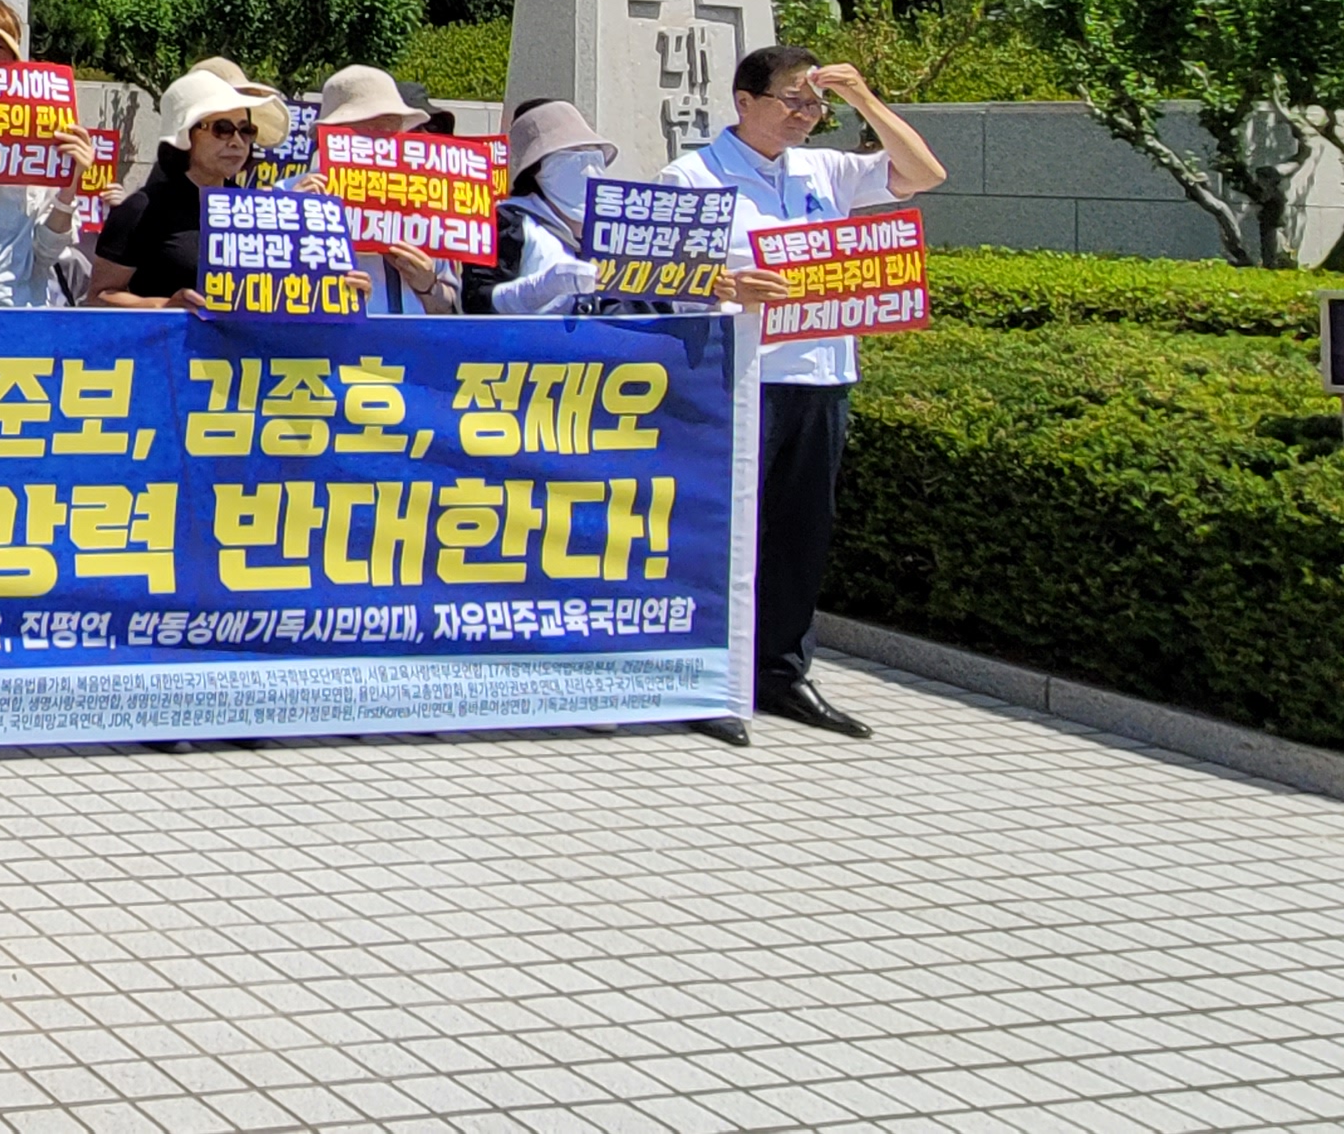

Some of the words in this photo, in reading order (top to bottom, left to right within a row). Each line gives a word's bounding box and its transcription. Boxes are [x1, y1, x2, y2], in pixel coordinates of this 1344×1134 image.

[36, 105, 74, 138] 판사
[327, 134, 397, 168] 법문언
[403, 140, 488, 179] 무시하는
[207, 194, 300, 230] 동성결혼
[303, 198, 345, 233] 옹호
[326, 167, 448, 211] 사법적극주의
[453, 180, 491, 217] 판사
[595, 184, 699, 223] 동성결혼
[700, 192, 734, 224] 옹호
[208, 232, 293, 268] 대법관
[300, 234, 353, 271] 추천
[593, 221, 680, 257] 대법관
[683, 227, 728, 259] 추천
[758, 229, 832, 265] 법문언
[836, 219, 917, 255] 무시하는
[780, 256, 880, 298] 법적극주의
[885, 251, 922, 286] 판사
[766, 288, 924, 335] 배제하라!
[182, 355, 431, 461] 김종호,
[451, 361, 668, 459] 정재오
[212, 475, 675, 594] 반대한다!
[20, 610, 116, 649] 진평연,
[127, 607, 424, 647] 반동성애기독시민연대,
[433, 596, 696, 642] 자유민주교육국민연합
